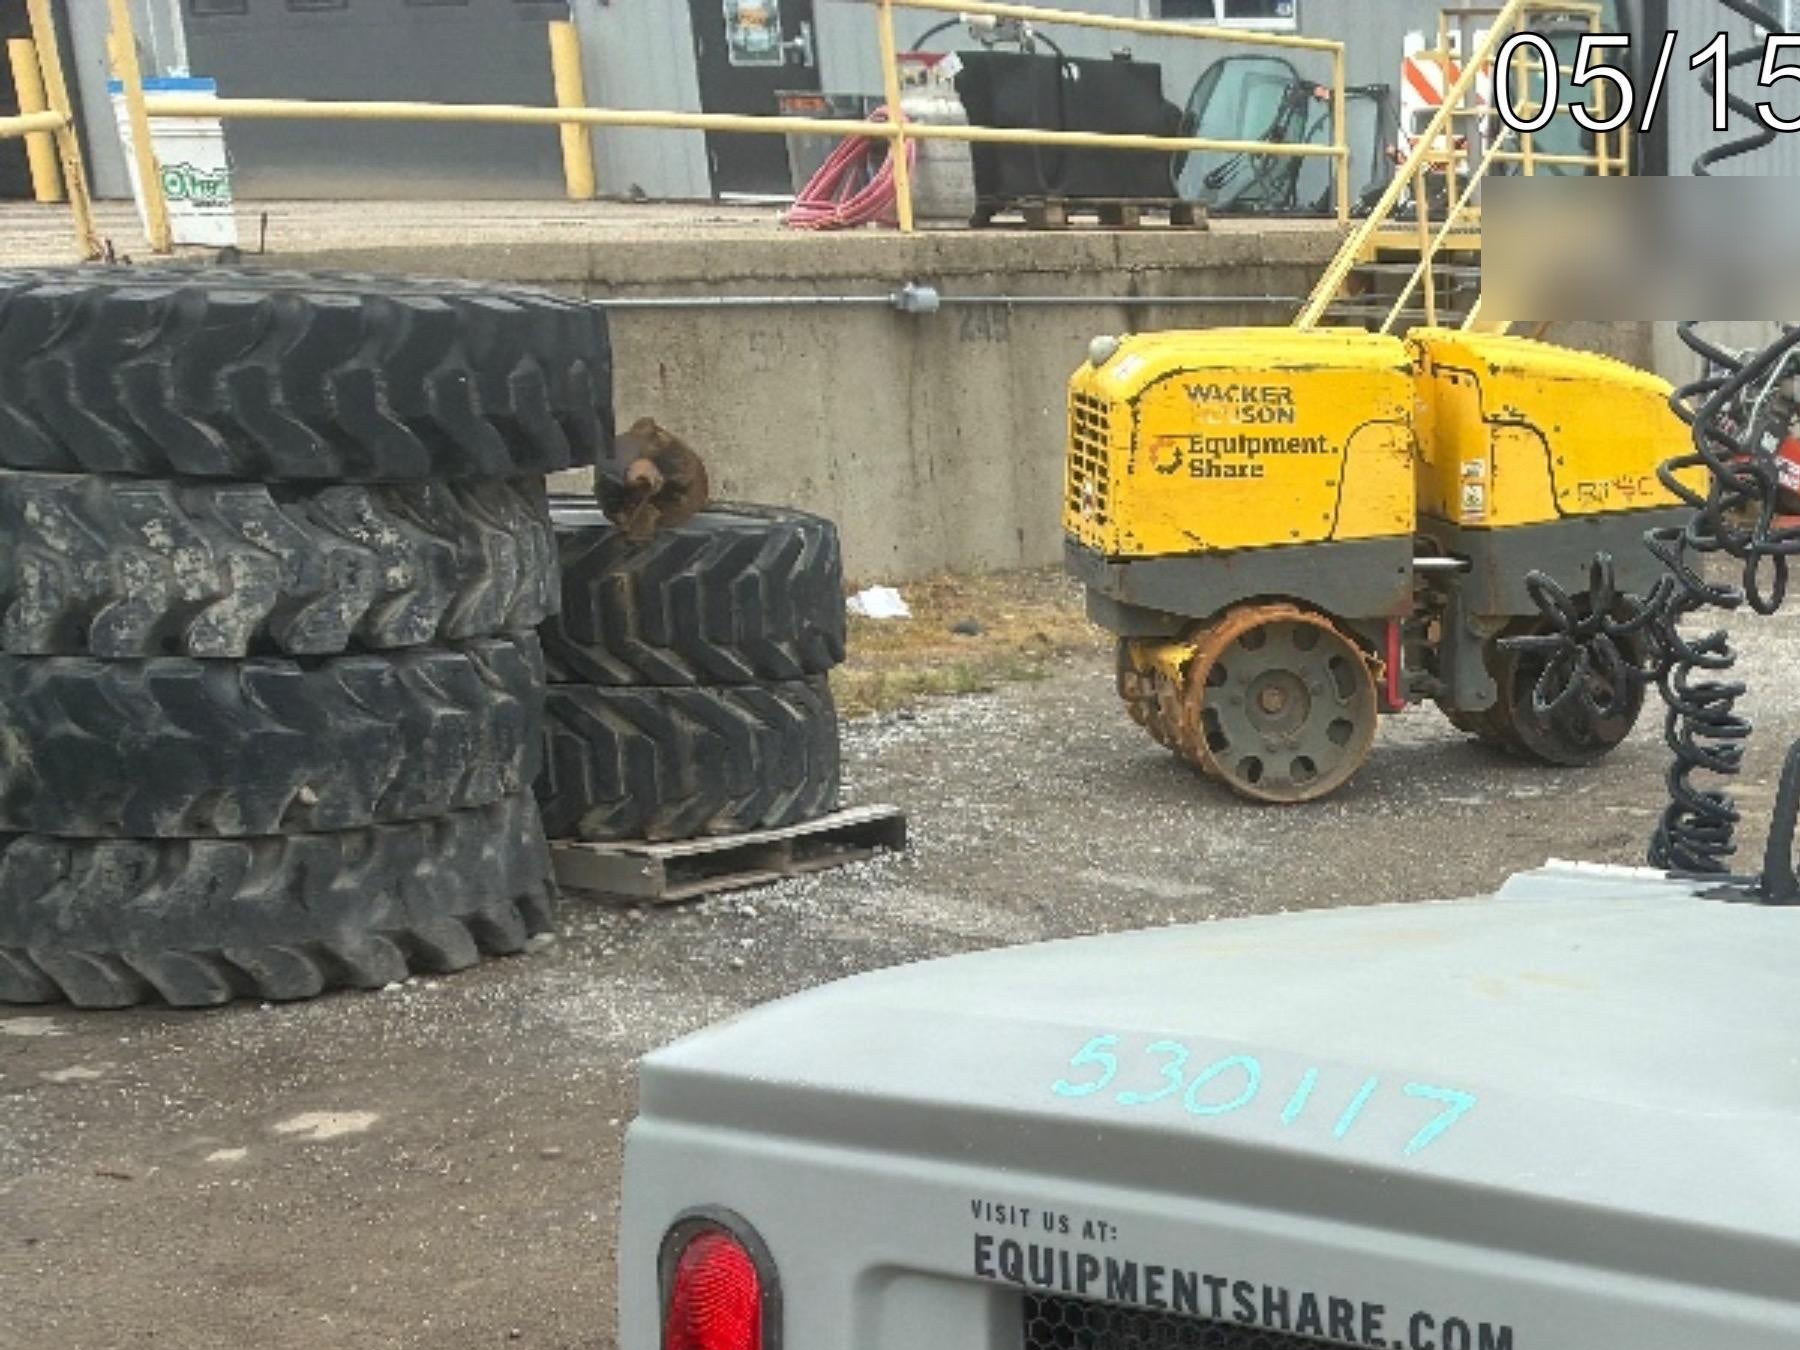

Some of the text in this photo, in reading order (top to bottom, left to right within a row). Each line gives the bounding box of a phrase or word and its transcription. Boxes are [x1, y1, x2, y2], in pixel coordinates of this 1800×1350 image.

[1188, 459, 1264, 477] Share
[1052, 1035, 1476, 1155] 530117
[971, 1199, 1117, 1242] VISIT US AT:
